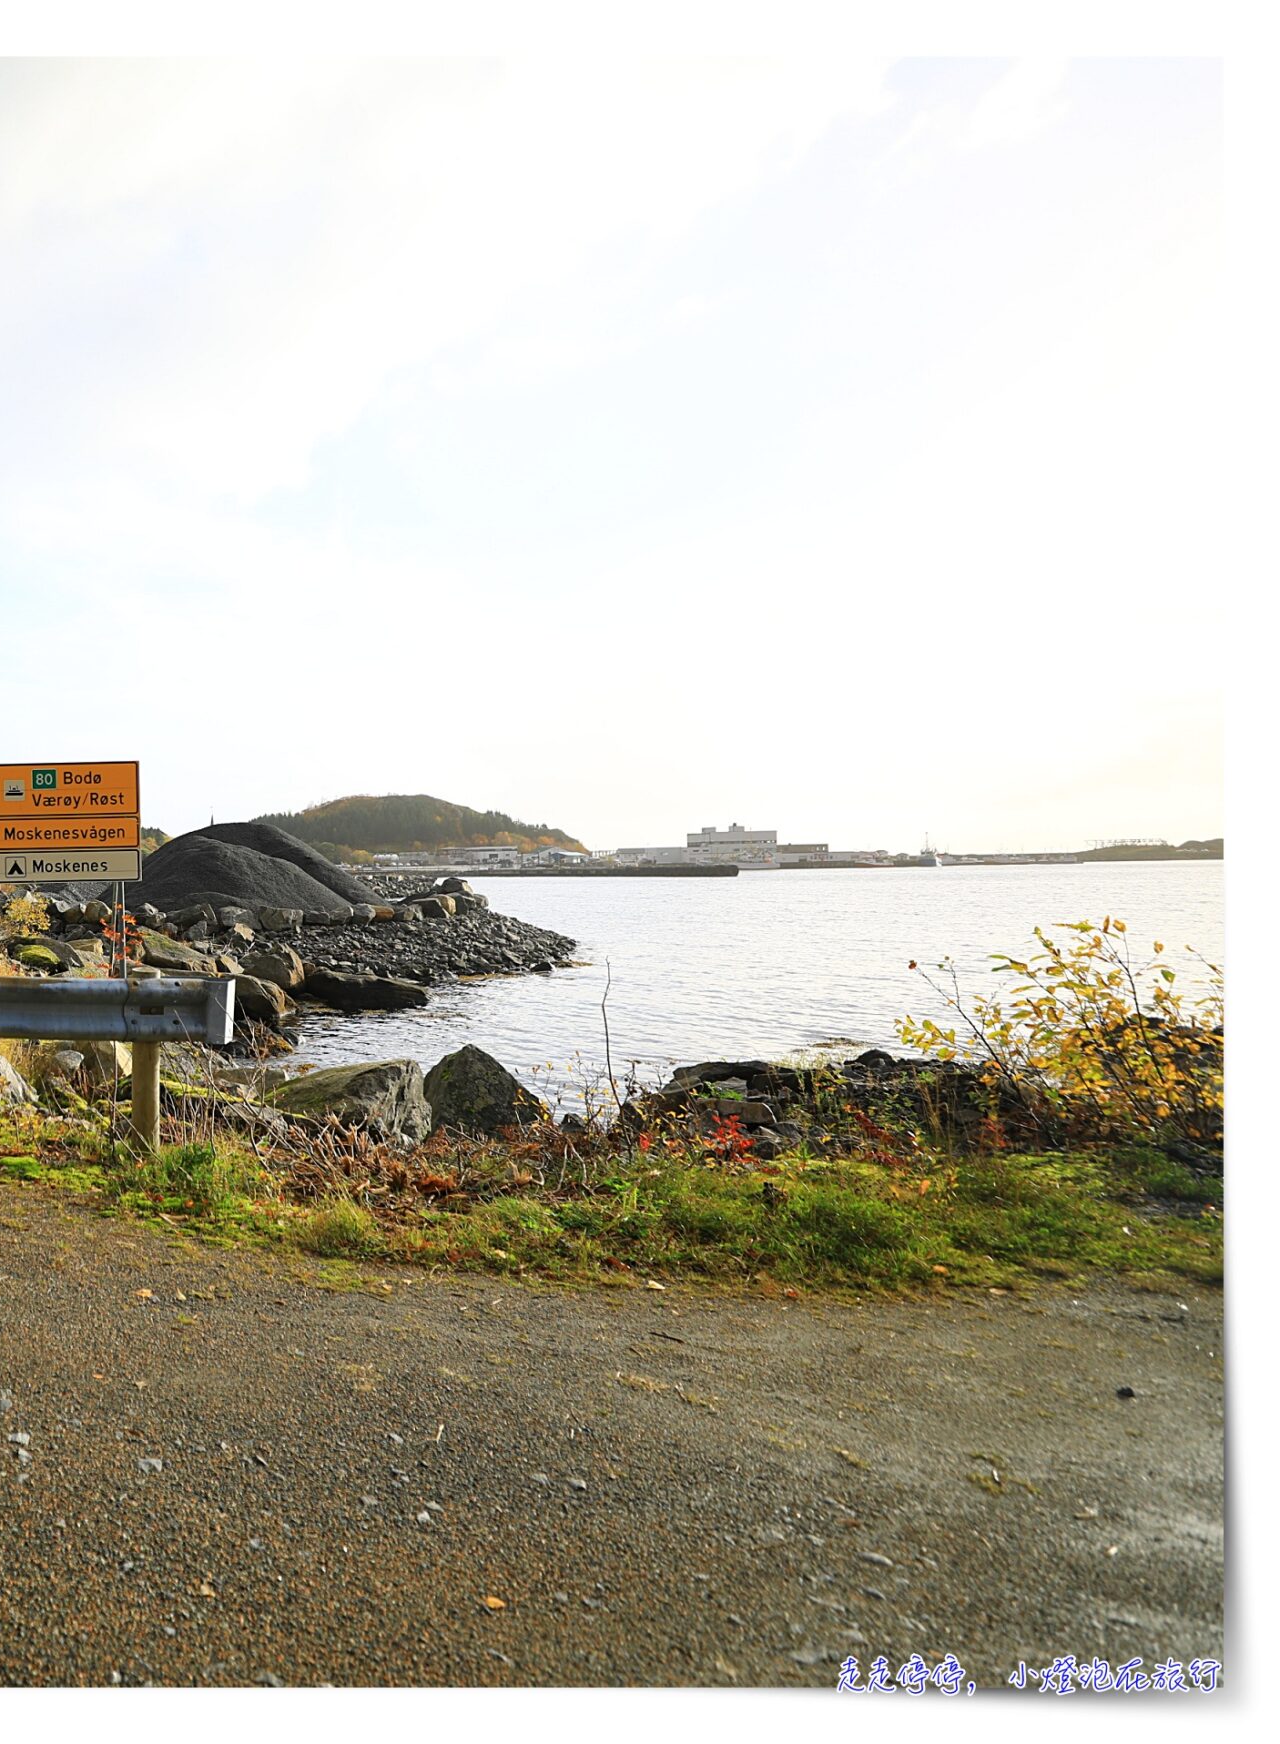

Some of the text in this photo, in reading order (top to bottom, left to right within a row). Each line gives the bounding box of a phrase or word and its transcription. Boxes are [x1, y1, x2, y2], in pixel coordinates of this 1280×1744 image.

[35, 771, 102, 786] 80 Bodø
[32, 792, 125, 809] Værøy/Røst
[4, 825, 125, 842] Moskenesvågen
[32, 859, 108, 874] Moskenes
